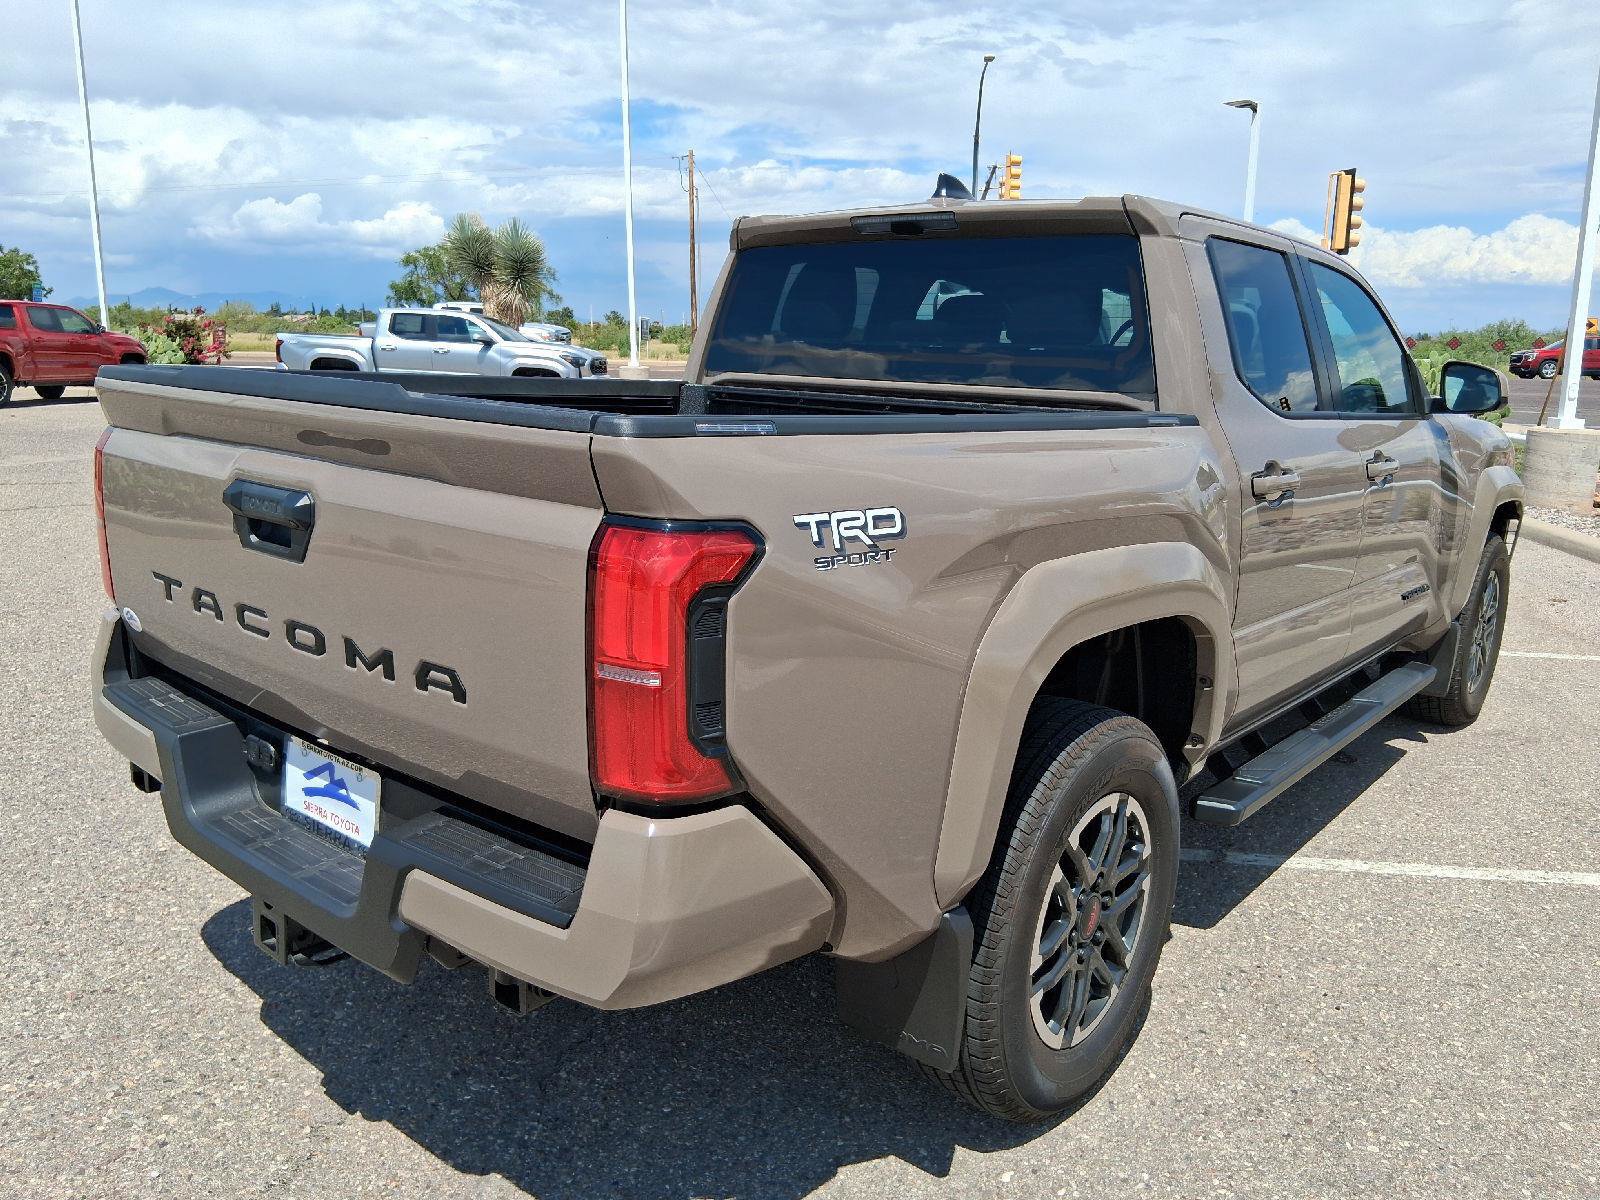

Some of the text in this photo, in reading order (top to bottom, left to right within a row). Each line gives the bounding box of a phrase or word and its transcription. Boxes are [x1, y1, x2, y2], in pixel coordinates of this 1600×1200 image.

[792, 506, 907, 554] TRD
[813, 548, 897, 572] SPORT
[151, 570, 468, 705] TACOMA
[303, 800, 328, 820] SIERRA
[330, 812, 361, 836] TOYOTA
